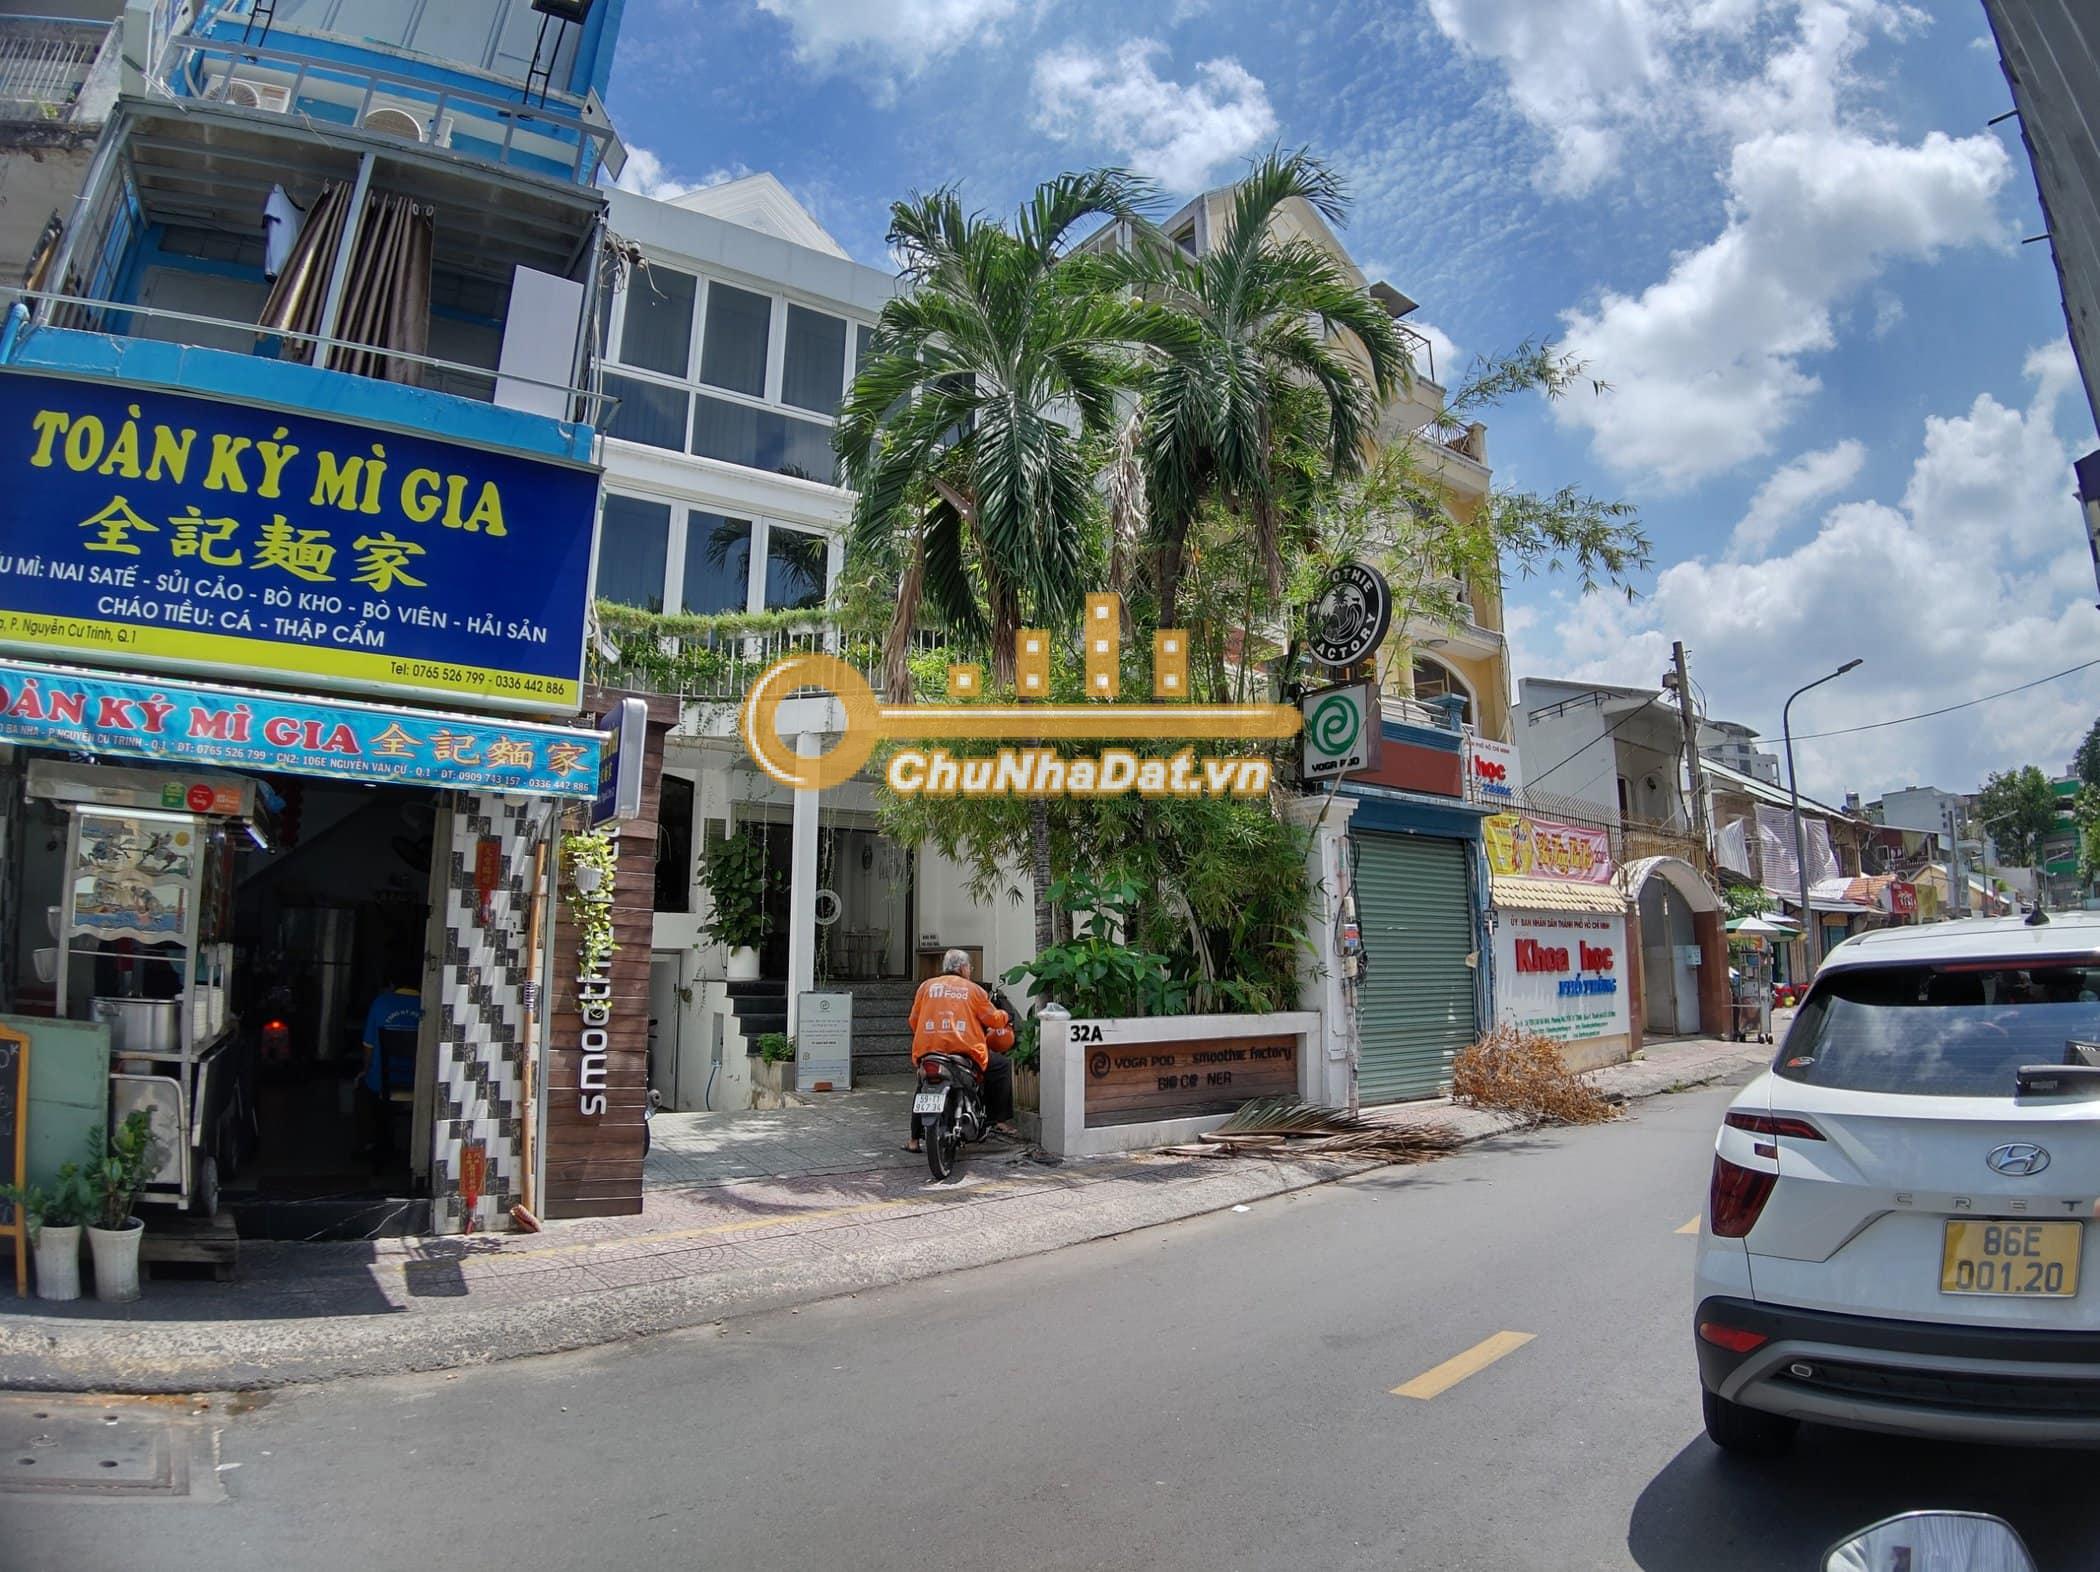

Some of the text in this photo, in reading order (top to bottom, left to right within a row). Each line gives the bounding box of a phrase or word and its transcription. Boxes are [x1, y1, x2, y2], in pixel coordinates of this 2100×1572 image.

[30, 403, 508, 537] TOÀN KÝ MÌ GIA
[16, 554, 45, 577] MÌ:
[50, 561, 84, 582] NAI
[88, 564, 140, 588] SATẾ
[155, 569, 189, 594] SỦI
[194, 575, 244, 601] CẢO
[263, 585, 292, 607] BÒ
[298, 592, 342, 614] KHO
[362, 599, 391, 620] BÒ
[397, 605, 448, 629] VIÊN
[466, 613, 502, 637] HẢI
[506, 619, 547, 644] SẢN
[97, 595, 159, 619] CHÁO
[164, 598, 214, 627] TIỀU:
[220, 609, 252, 631] CÁ
[274, 617, 327, 642] THẬP
[332, 620, 385, 647] CẨM
[390, 660, 410, 676] Tel:
[412, 663, 439, 680] 0765
[442, 668, 462, 682] 526
[465, 671, 485, 686] 799
[495, 674, 521, 689] 0336
[524, 679, 543, 694] 442
[546, 681, 565, 696] 886
[96, 693, 177, 734] KÝ
[188, 703, 253, 742] MÌ
[263, 716, 363, 756] GIA
[1515, 938, 1614, 975] Khoa học
[944, 989, 969, 1000] Food
[1070, 1025, 1103, 1042] 32A
[1151, 1055, 1175, 1067] POD
[1983, 1226, 2043, 1257] 86E
[1956, 1260, 2064, 1292] 001.20
